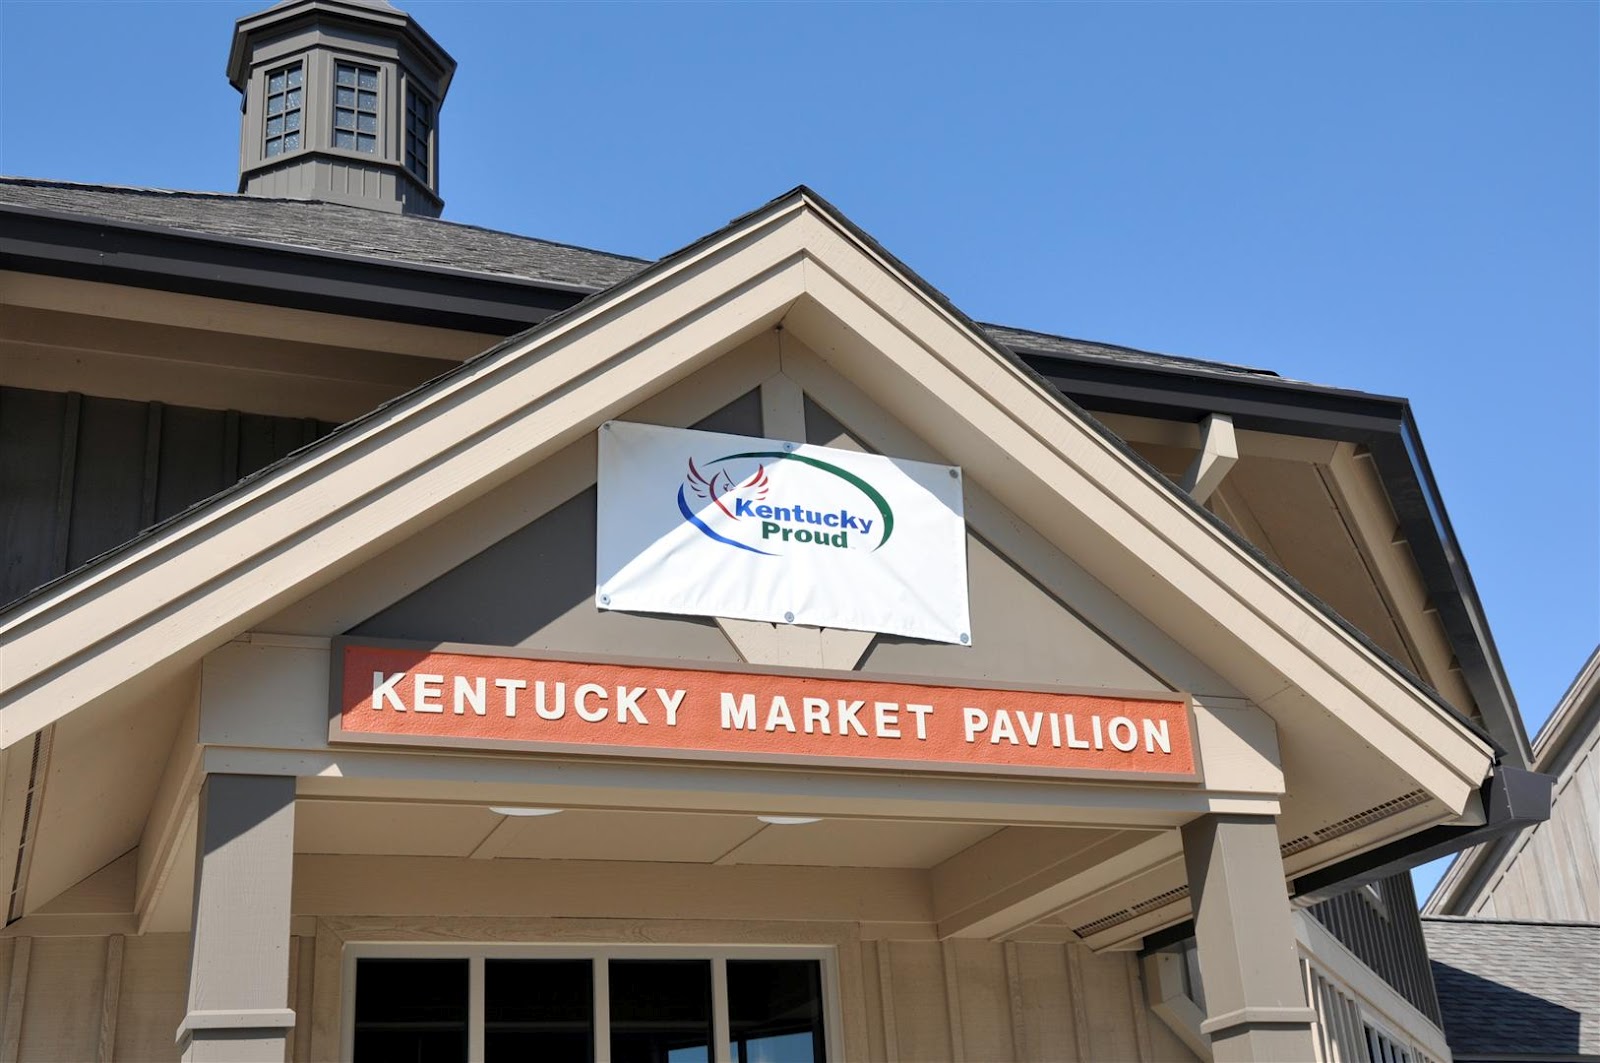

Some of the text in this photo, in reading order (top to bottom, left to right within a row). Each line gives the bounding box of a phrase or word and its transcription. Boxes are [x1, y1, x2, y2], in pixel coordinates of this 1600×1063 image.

[735, 498, 873, 534] Kentucky
[761, 521, 848, 549] Proud
[371, 671, 1172, 754] KENTUCKY MARKET PAVILION
